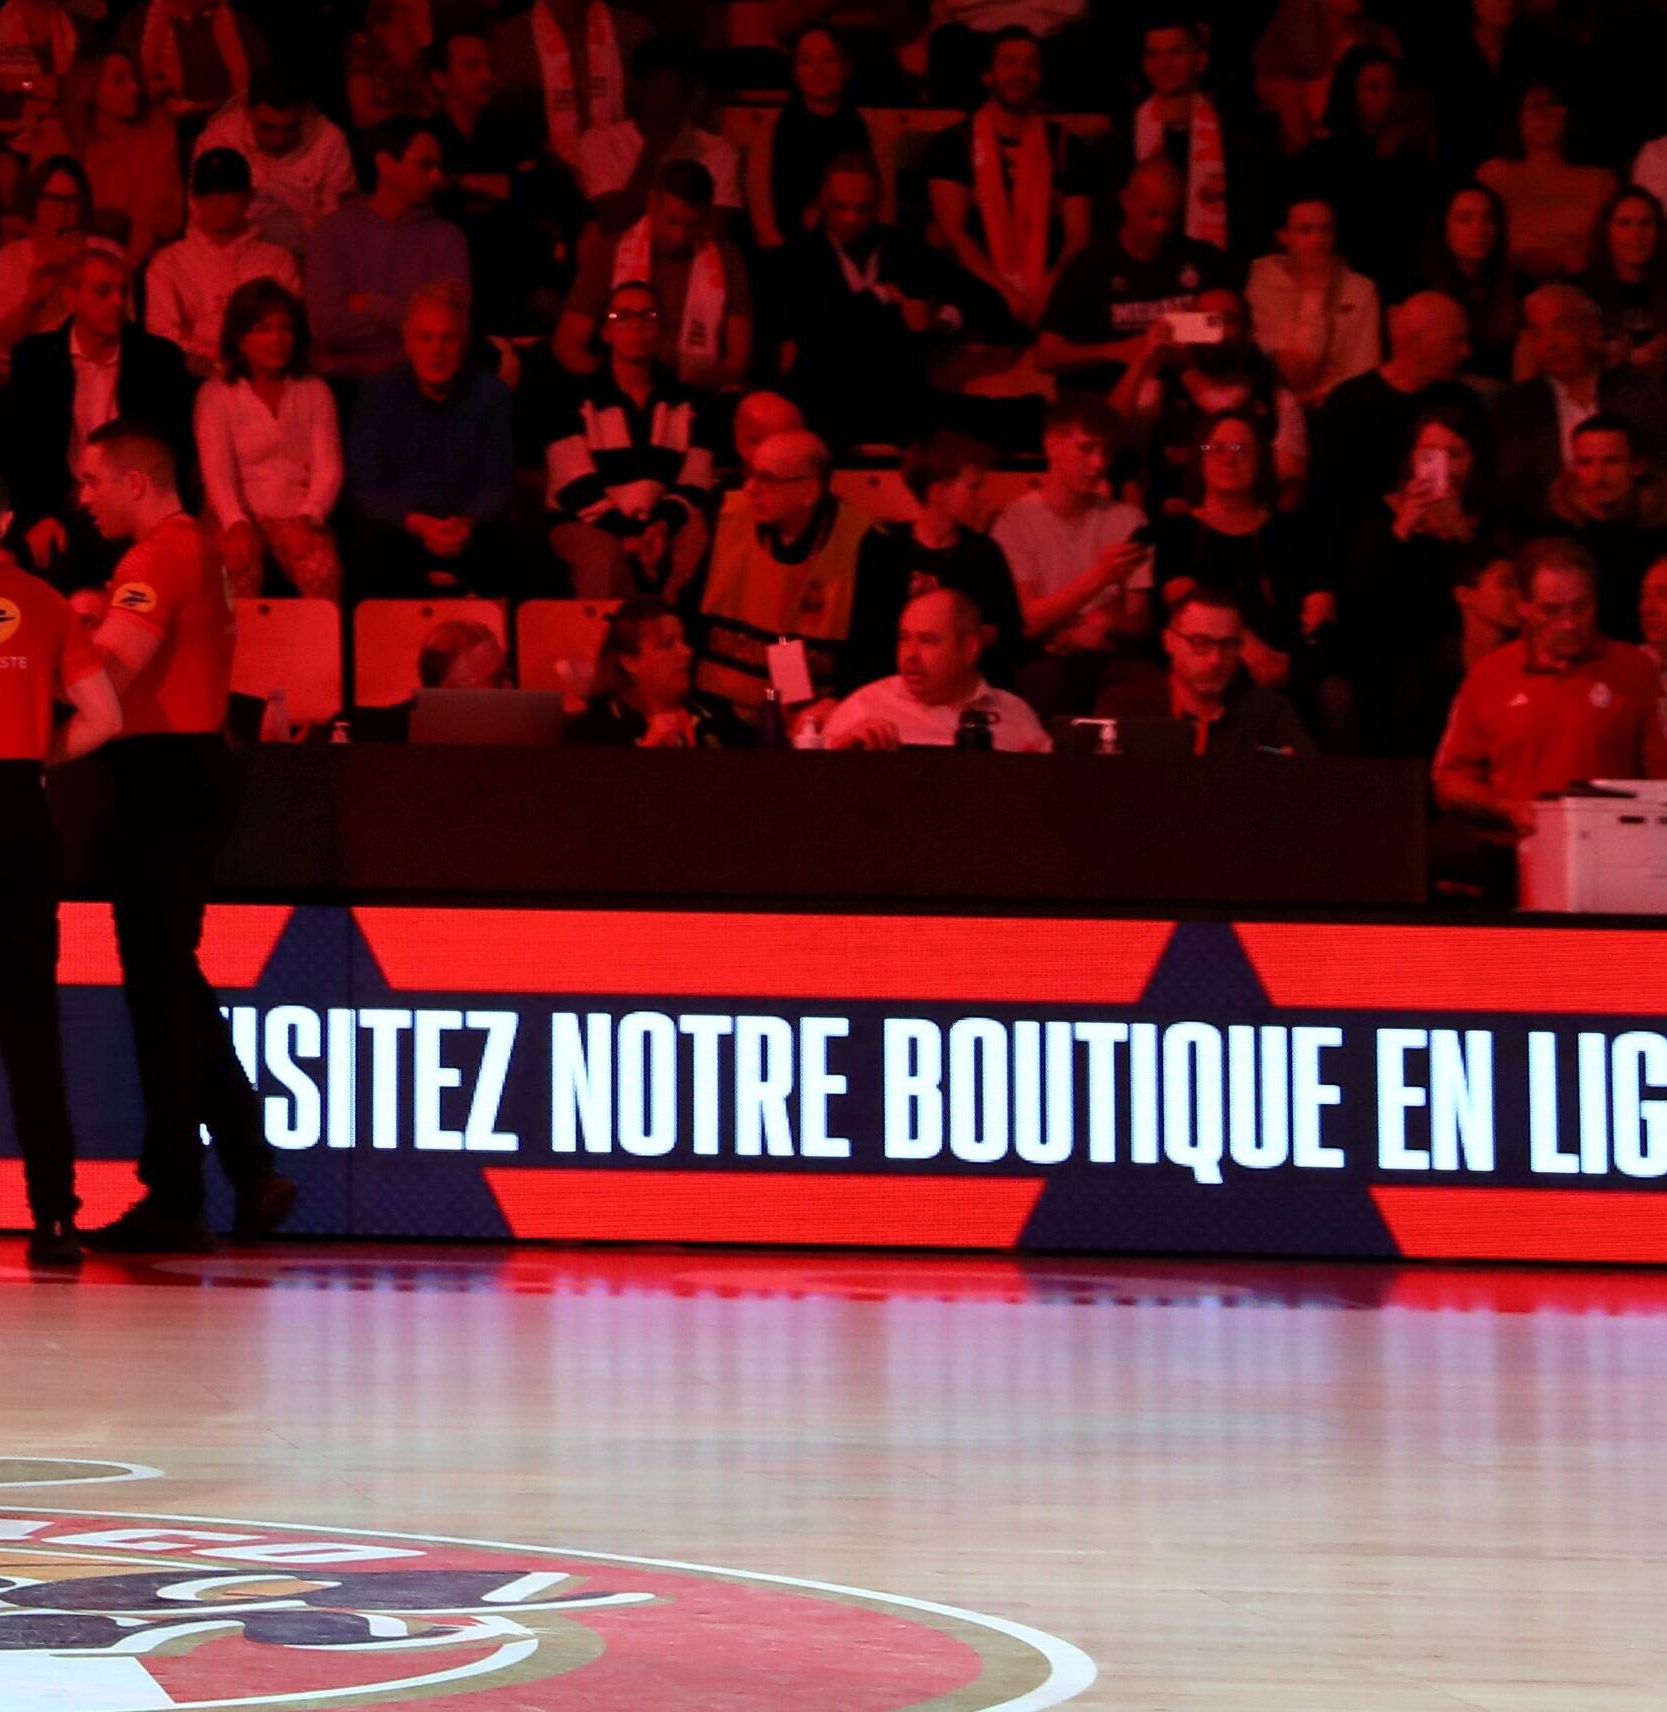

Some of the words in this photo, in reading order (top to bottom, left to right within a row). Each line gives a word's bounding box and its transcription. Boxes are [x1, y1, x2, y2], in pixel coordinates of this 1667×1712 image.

[200, 1005, 519, 1151] SITEZ
[551, 1011, 850, 1157] NOTRE
[883, 1017, 1344, 1184] BOUTIQUE
[1376, 1028, 1495, 1171] EN
[1528, 1030, 1667, 1177] LIG
